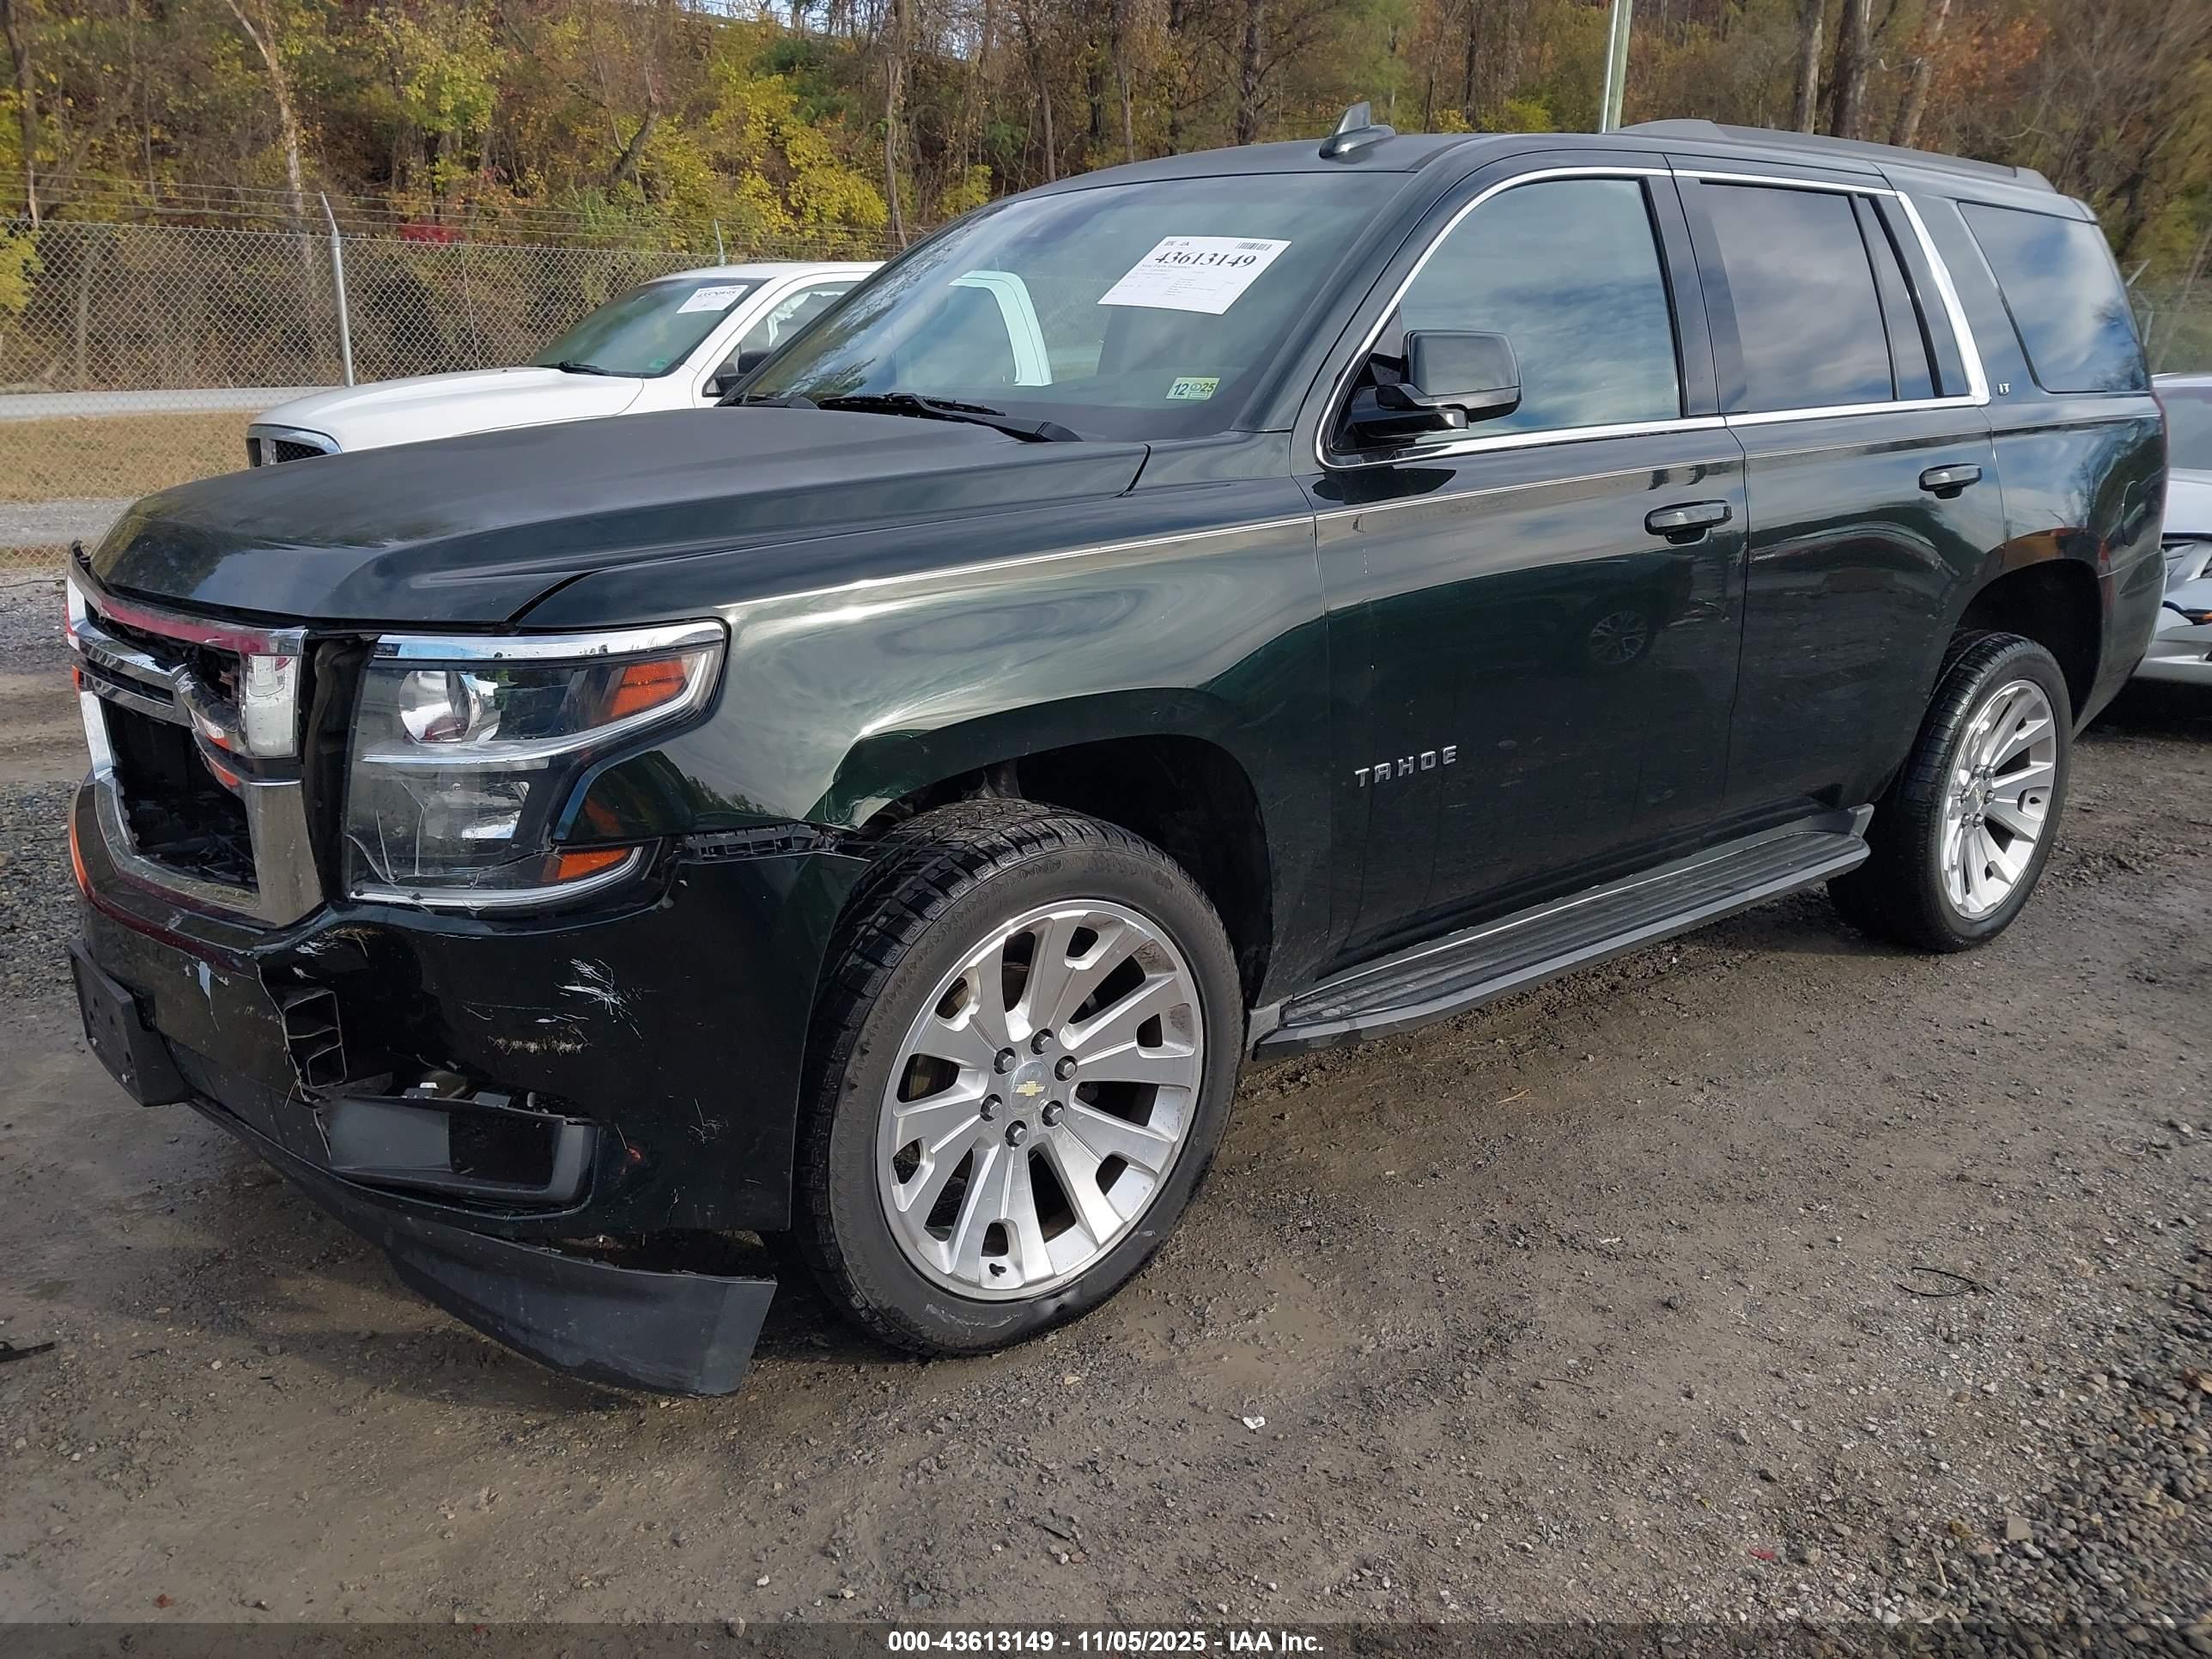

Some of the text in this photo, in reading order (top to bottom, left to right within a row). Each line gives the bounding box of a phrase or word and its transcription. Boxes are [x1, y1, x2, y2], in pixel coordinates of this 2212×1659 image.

[1154, 251, 1257, 268] 43613149
[1173, 383, 1189, 396] 12
[1200, 382, 1216, 392] 25
[1354, 744, 1457, 788] TAHOE
